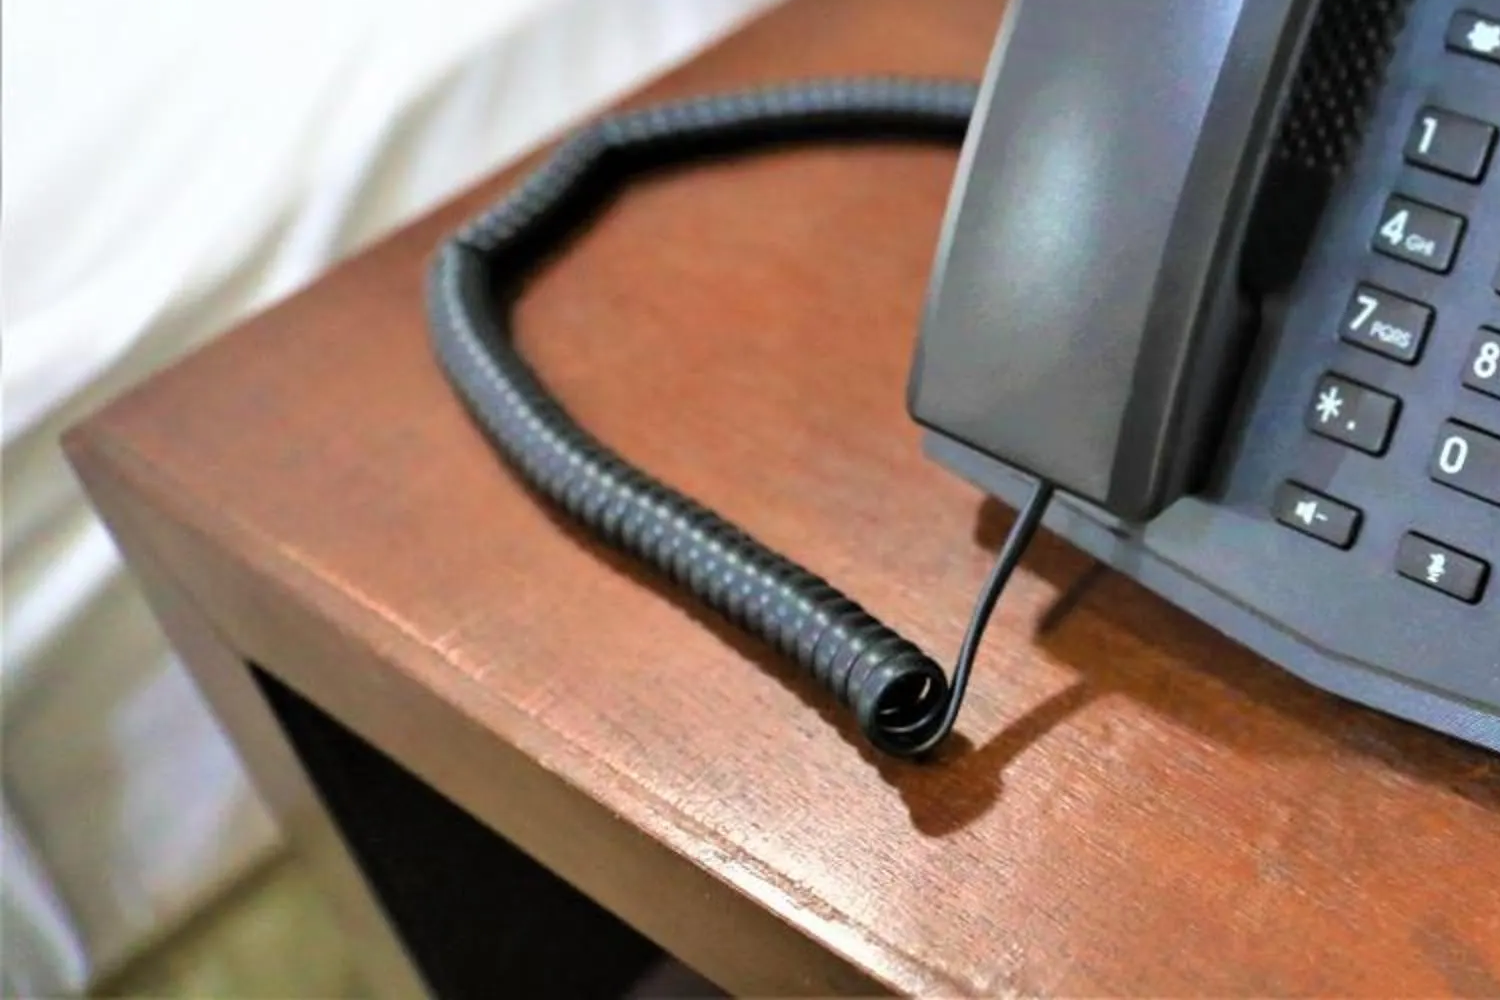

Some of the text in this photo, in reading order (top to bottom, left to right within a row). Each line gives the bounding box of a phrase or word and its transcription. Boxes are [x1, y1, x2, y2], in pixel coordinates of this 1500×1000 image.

[1418, 117, 1438, 154] 1
[1380, 210, 1409, 245] 4
[1349, 295, 1378, 331] 7
[1473, 341, 1500, 378] 8
[1439, 436, 1468, 474] 0
